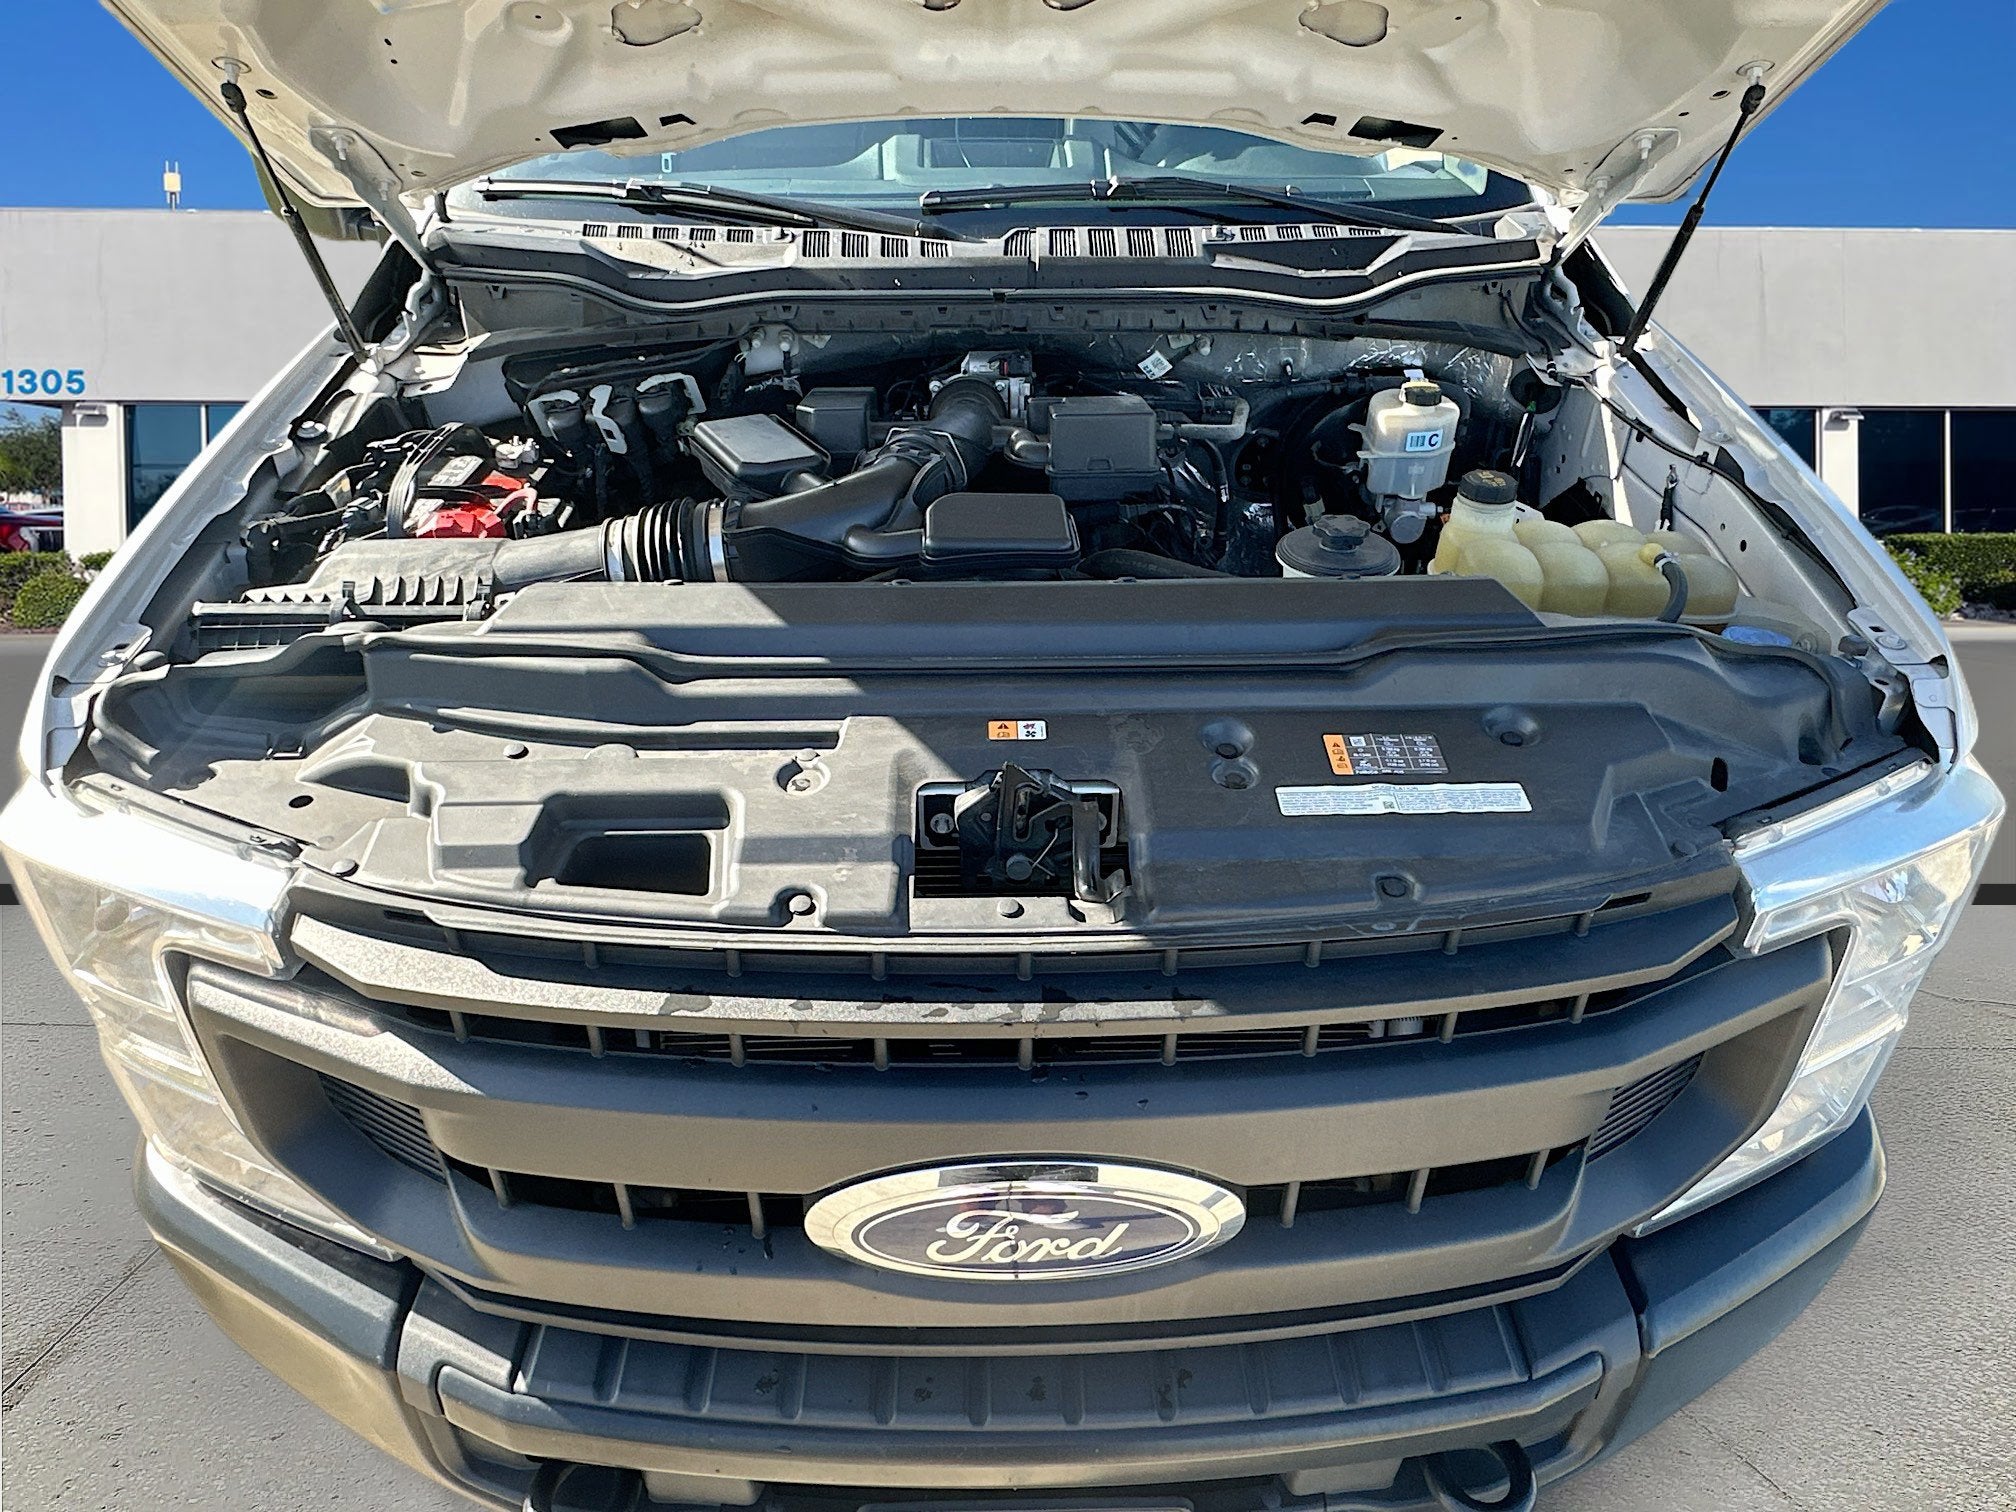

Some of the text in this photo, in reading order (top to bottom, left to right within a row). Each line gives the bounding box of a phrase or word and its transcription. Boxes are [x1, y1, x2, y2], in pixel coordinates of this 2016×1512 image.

[1, 370, 86, 395] 1305
[1428, 433, 1439, 448] C
[926, 1210, 1130, 1262] Ford
